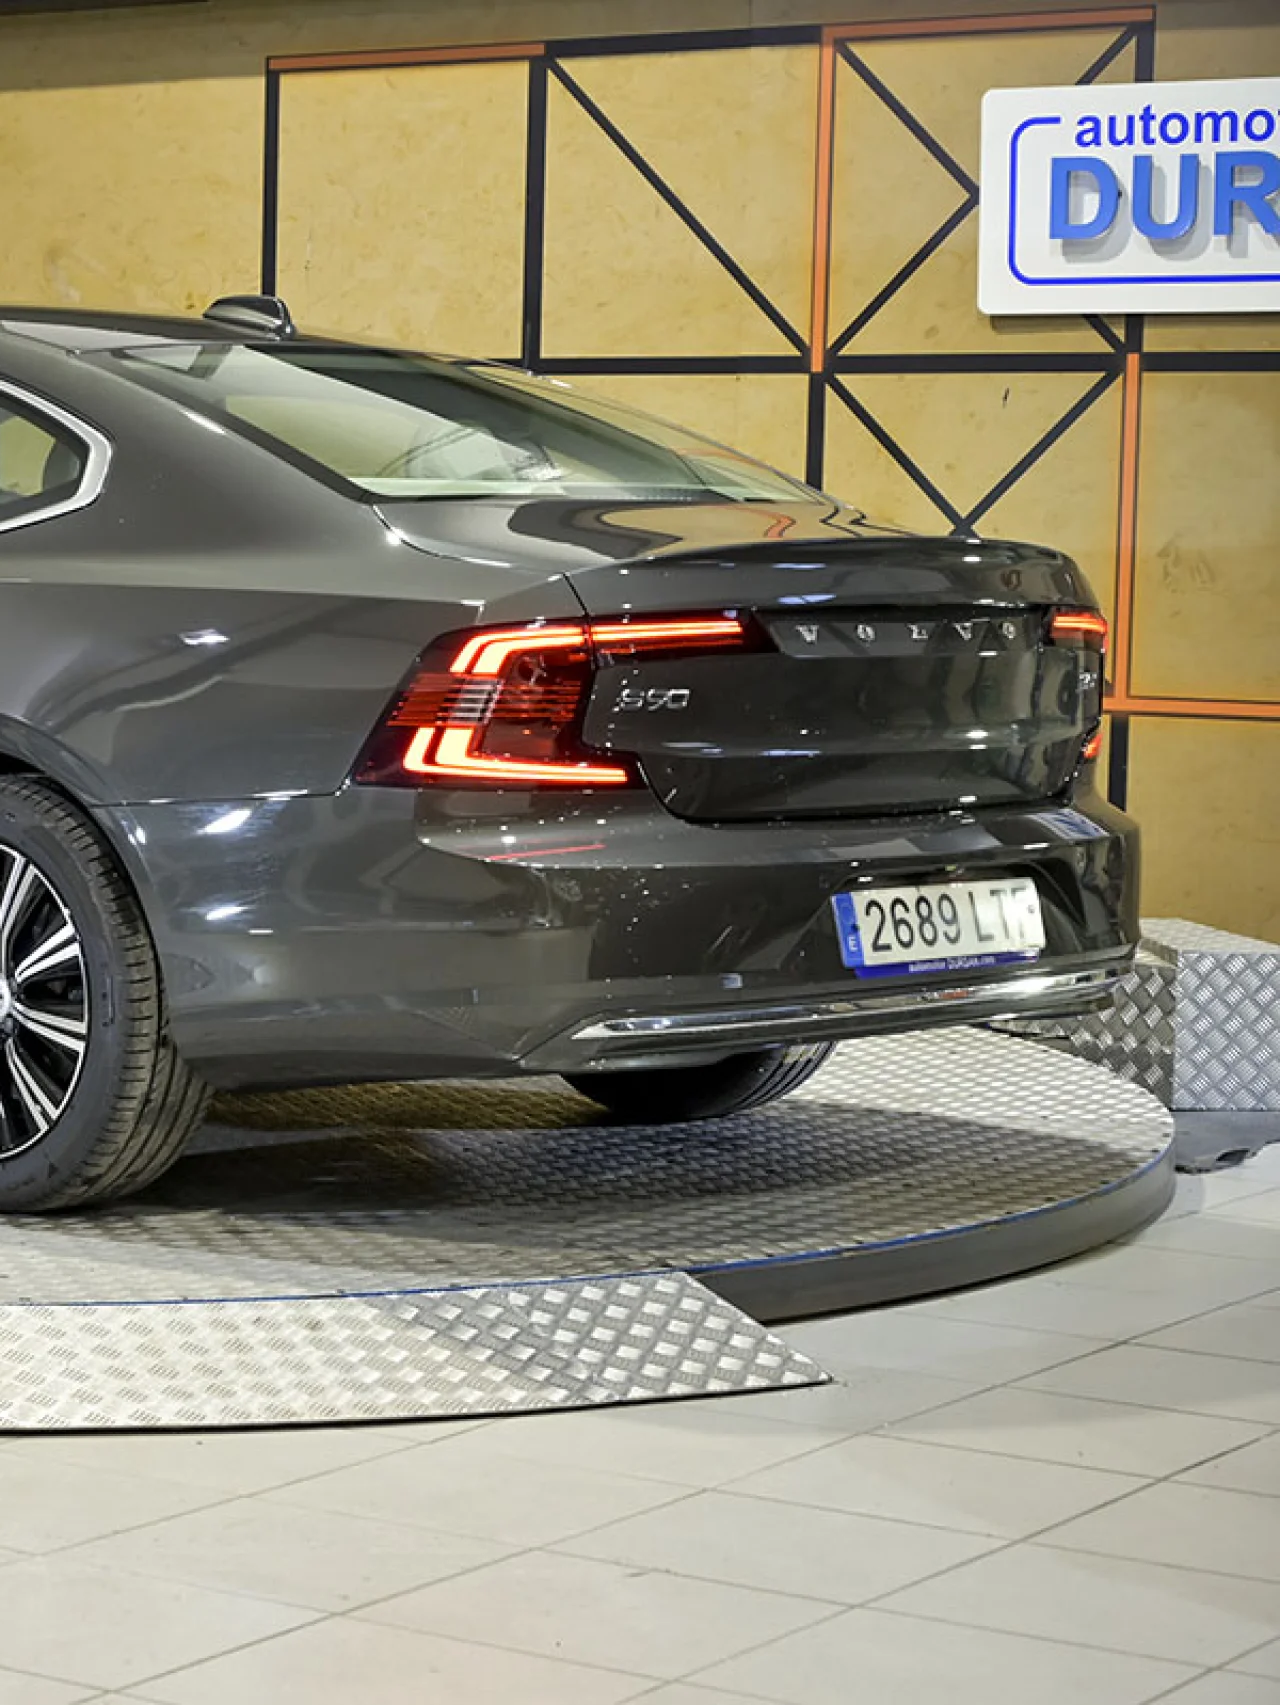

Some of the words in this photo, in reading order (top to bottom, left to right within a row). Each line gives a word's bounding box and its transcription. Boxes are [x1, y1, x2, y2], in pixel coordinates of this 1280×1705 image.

[1074, 103, 1280, 147] automo
[1049, 150, 1280, 240] DUR
[795, 621, 1017, 643] VOLVO
[620, 688, 690, 711] S90
[865, 893, 961, 953] 2689
